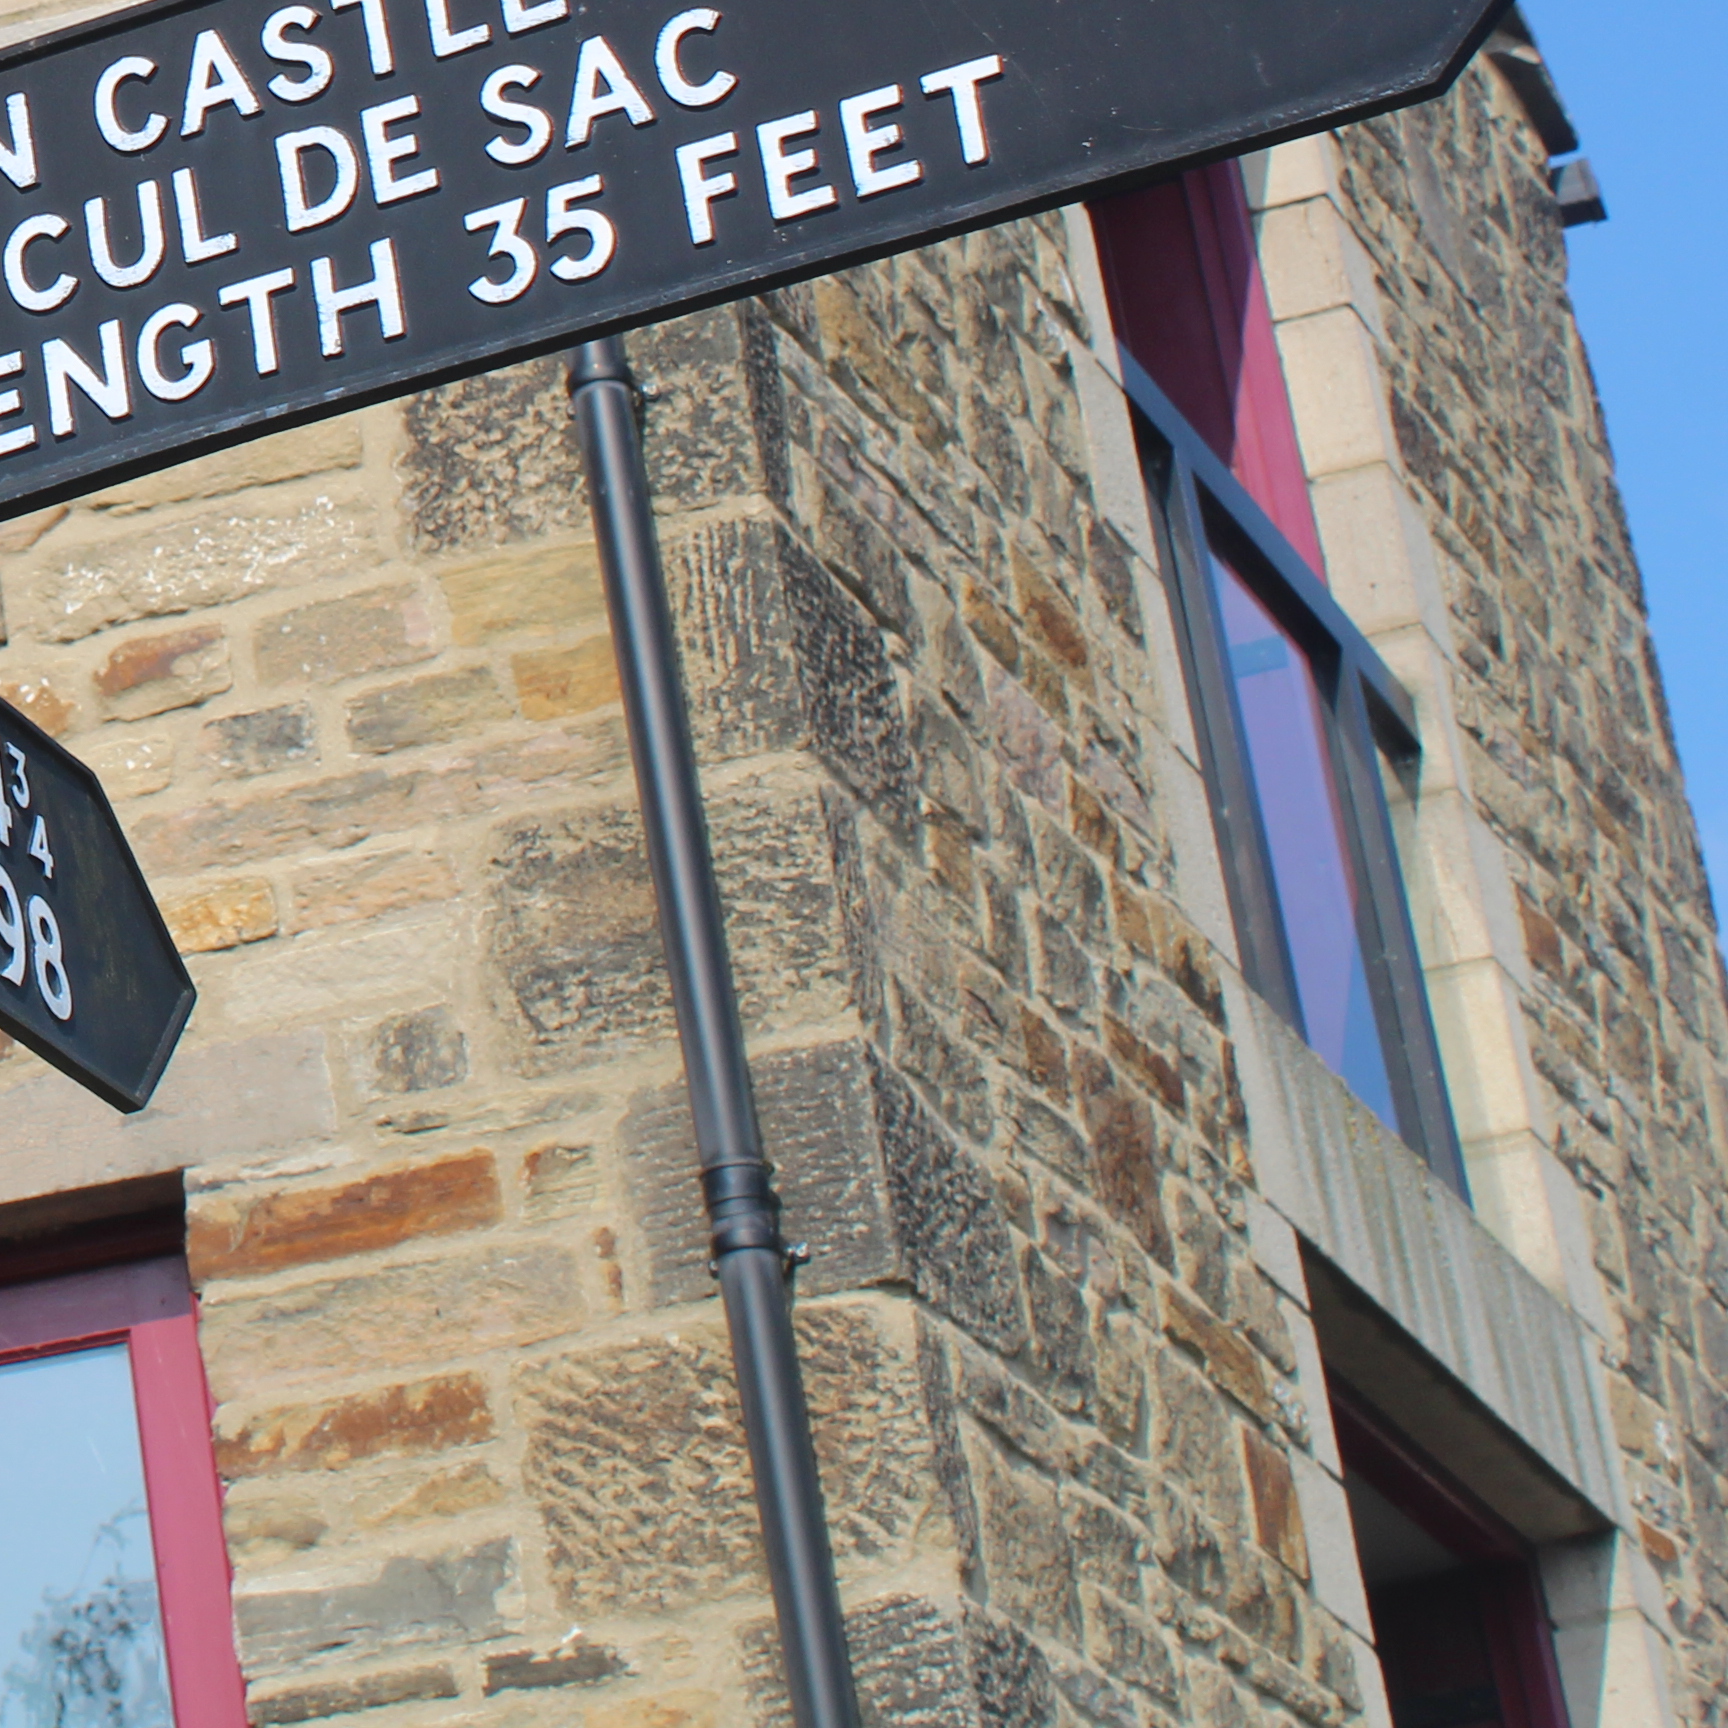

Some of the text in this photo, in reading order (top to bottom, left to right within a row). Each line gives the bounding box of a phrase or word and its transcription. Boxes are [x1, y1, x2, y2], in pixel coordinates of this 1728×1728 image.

[274, 93, 441, 234] DE
[480, 6, 738, 166] SAC
[463, 173, 617, 305] 35
[674, 53, 1004, 247] FEET
